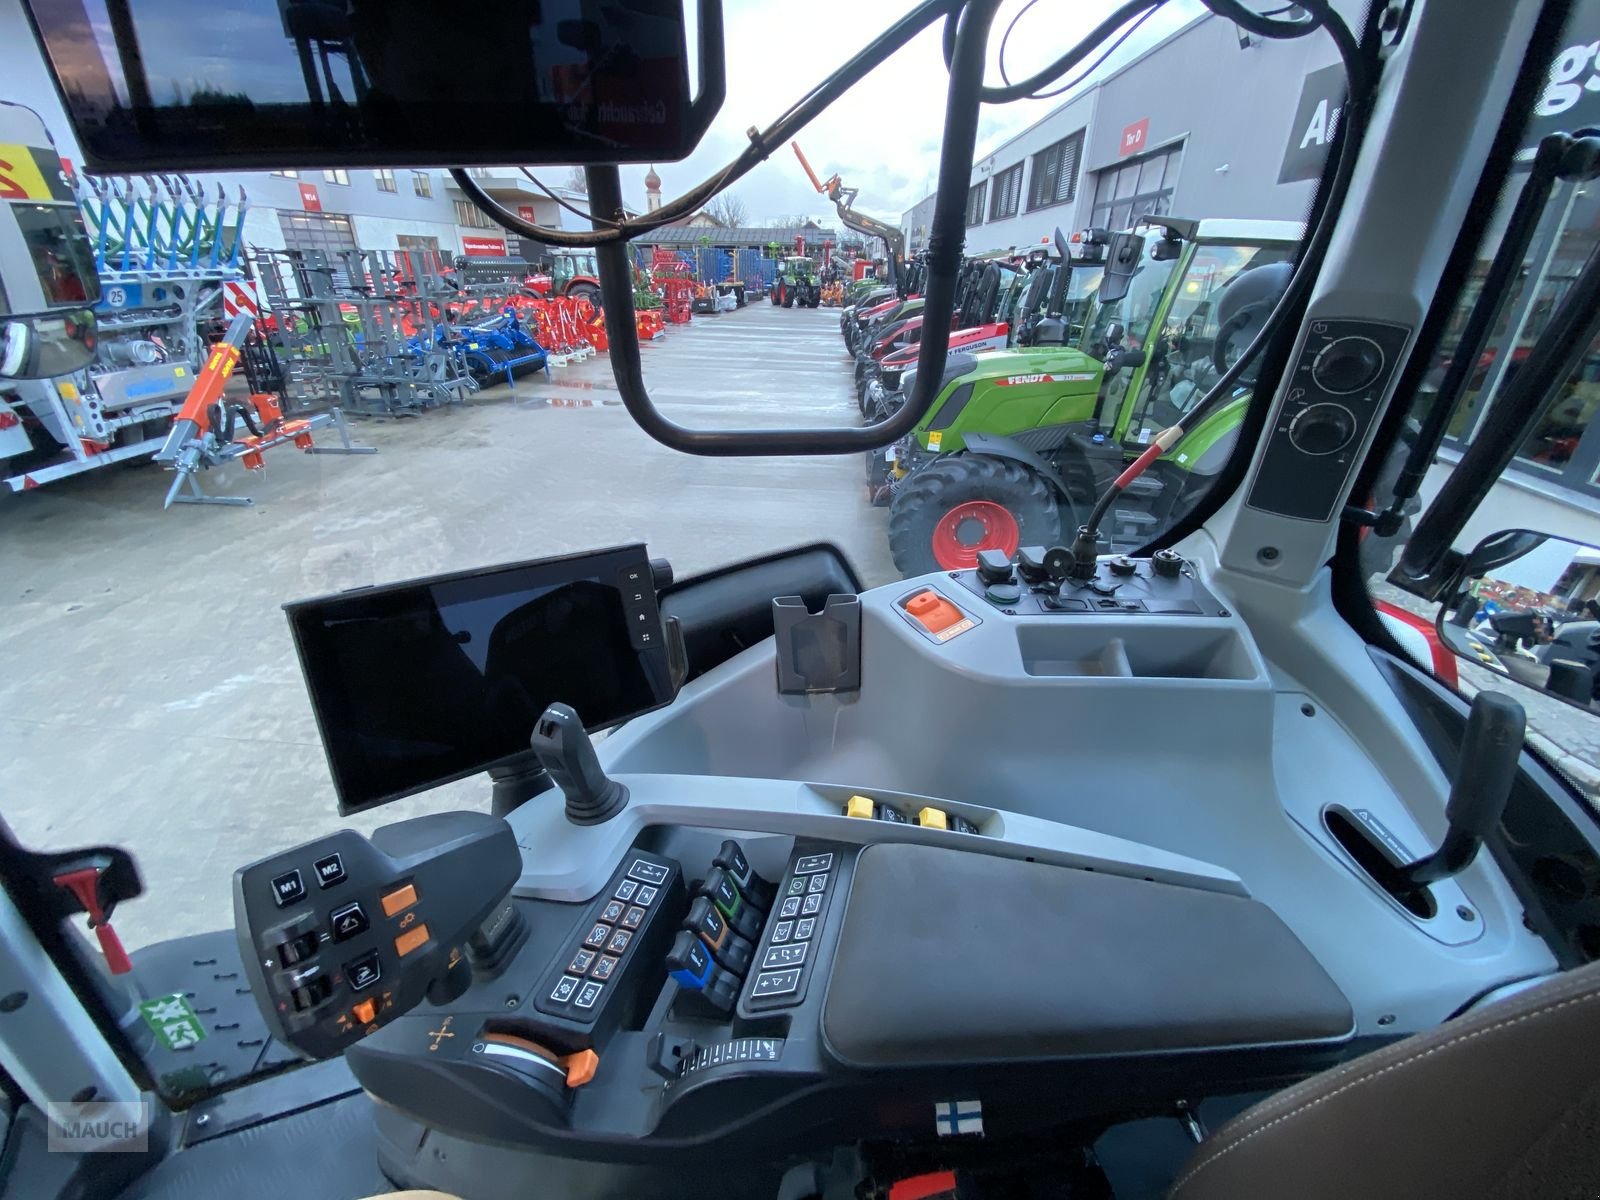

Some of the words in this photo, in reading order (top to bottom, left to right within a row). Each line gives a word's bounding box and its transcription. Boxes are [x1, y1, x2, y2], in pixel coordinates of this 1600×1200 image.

[111, 290, 123, 303] 25
[954, 341, 987, 354] FERGUSON
[1008, 373, 1047, 385] FENDT
[321, 863, 339, 876] M2
[280, 880, 297, 894] M1
[583, 988, 595, 1001] M3
[769, 1051, 776, 1059] 10
